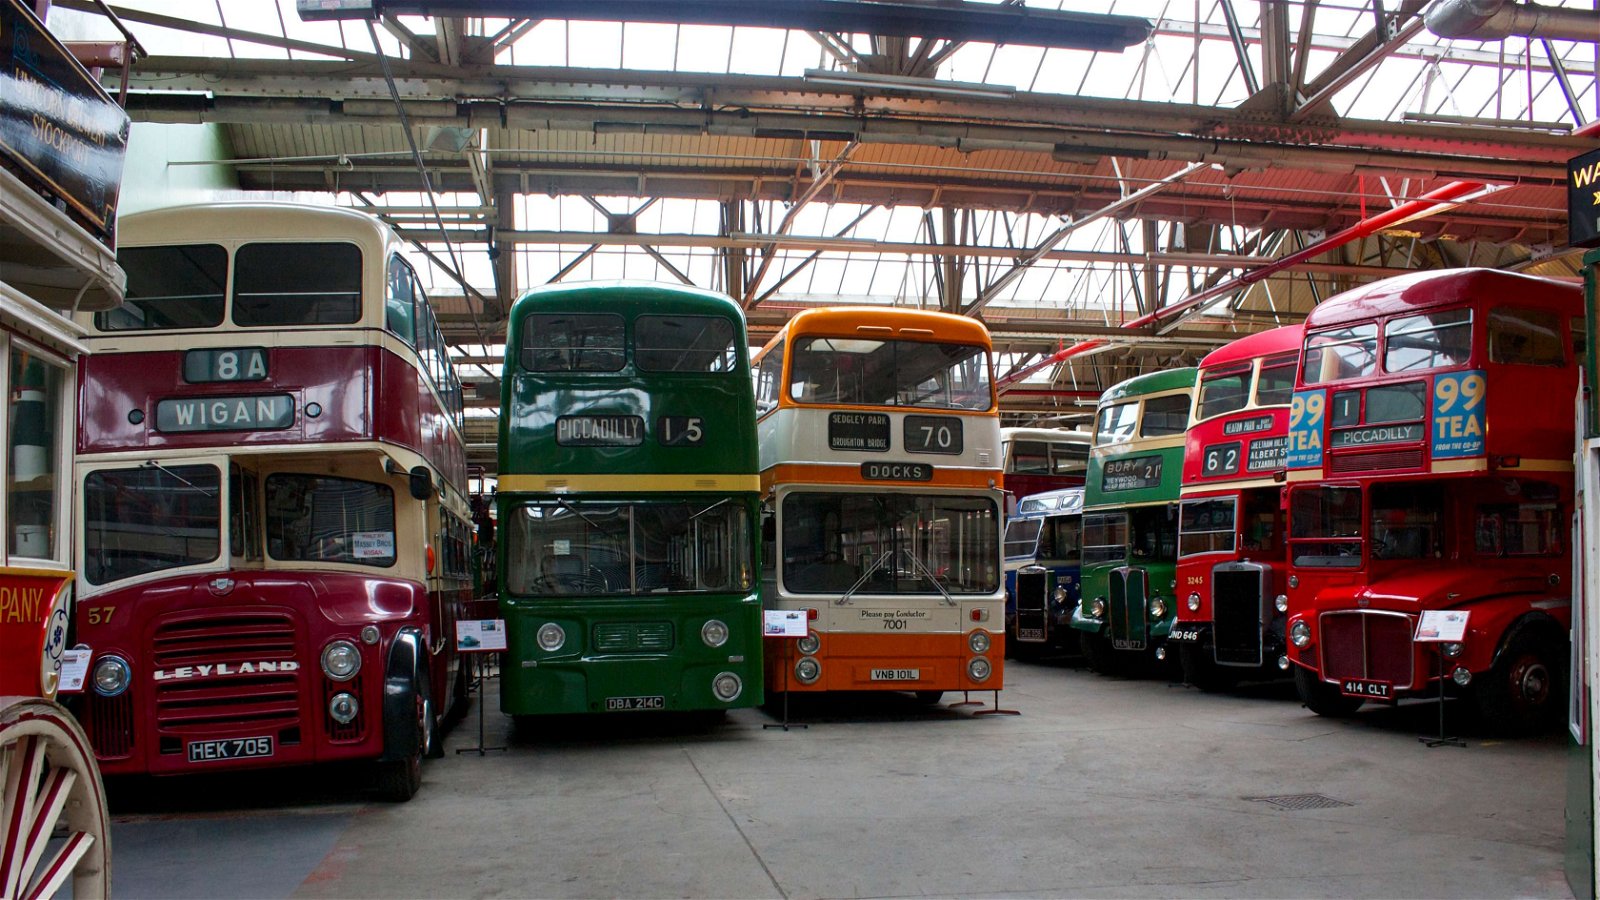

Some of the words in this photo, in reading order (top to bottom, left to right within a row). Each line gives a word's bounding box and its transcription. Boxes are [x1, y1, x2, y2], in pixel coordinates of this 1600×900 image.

[32, 112, 88, 165] STOCKPORT
[218, 352, 266, 379] 8A
[1436, 375, 1485, 413] 99
[176, 400, 275, 425] WIGAN
[1290, 394, 1324, 428] 99
[832, 414, 865, 425] SEDGLEY
[868, 416, 887, 425] PARK
[1243, 420, 1256, 431] PARK
[559, 419, 639, 439] PICCADILLY
[1435, 414, 1482, 439] TEA
[920, 426, 951, 448] 70
[1289, 429, 1321, 451] TEA
[1343, 426, 1412, 444] PICCADILLY
[832, 438, 865, 447] BROUGHTON
[867, 439, 887, 448] BRIDGE
[1435, 443, 1450, 451] FROM
[1451, 442, 1463, 450] THE
[1463, 441, 1481, 449] CO-OP
[1249, 448, 1279, 460] ALBERT
[870, 465, 922, 478] DOCKS
[1107, 461, 1138, 474] BURY
[1248, 460, 1276, 470] ALEXANDRA
[354, 540, 376, 548] MASSEY
[1187, 576, 1203, 585] 3245
[88, 606, 116, 625] 57
[861, 610, 882, 618] Please
[896, 610, 926, 618] Conductor
[883, 620, 907, 629] 7001
[1168, 631, 1182, 640] JND
[1182, 631, 1198, 640] 646
[153, 661, 299, 681] LEYLAND
[875, 670, 895, 679] VNB
[897, 670, 916, 679] 101L
[1346, 682, 1363, 693] 414
[1368, 684, 1387, 695] CLT
[609, 699, 632, 709] DBA
[636, 697, 662, 708] 214C
[192, 742, 229, 760] HEK
[233, 738, 270, 756] 705
